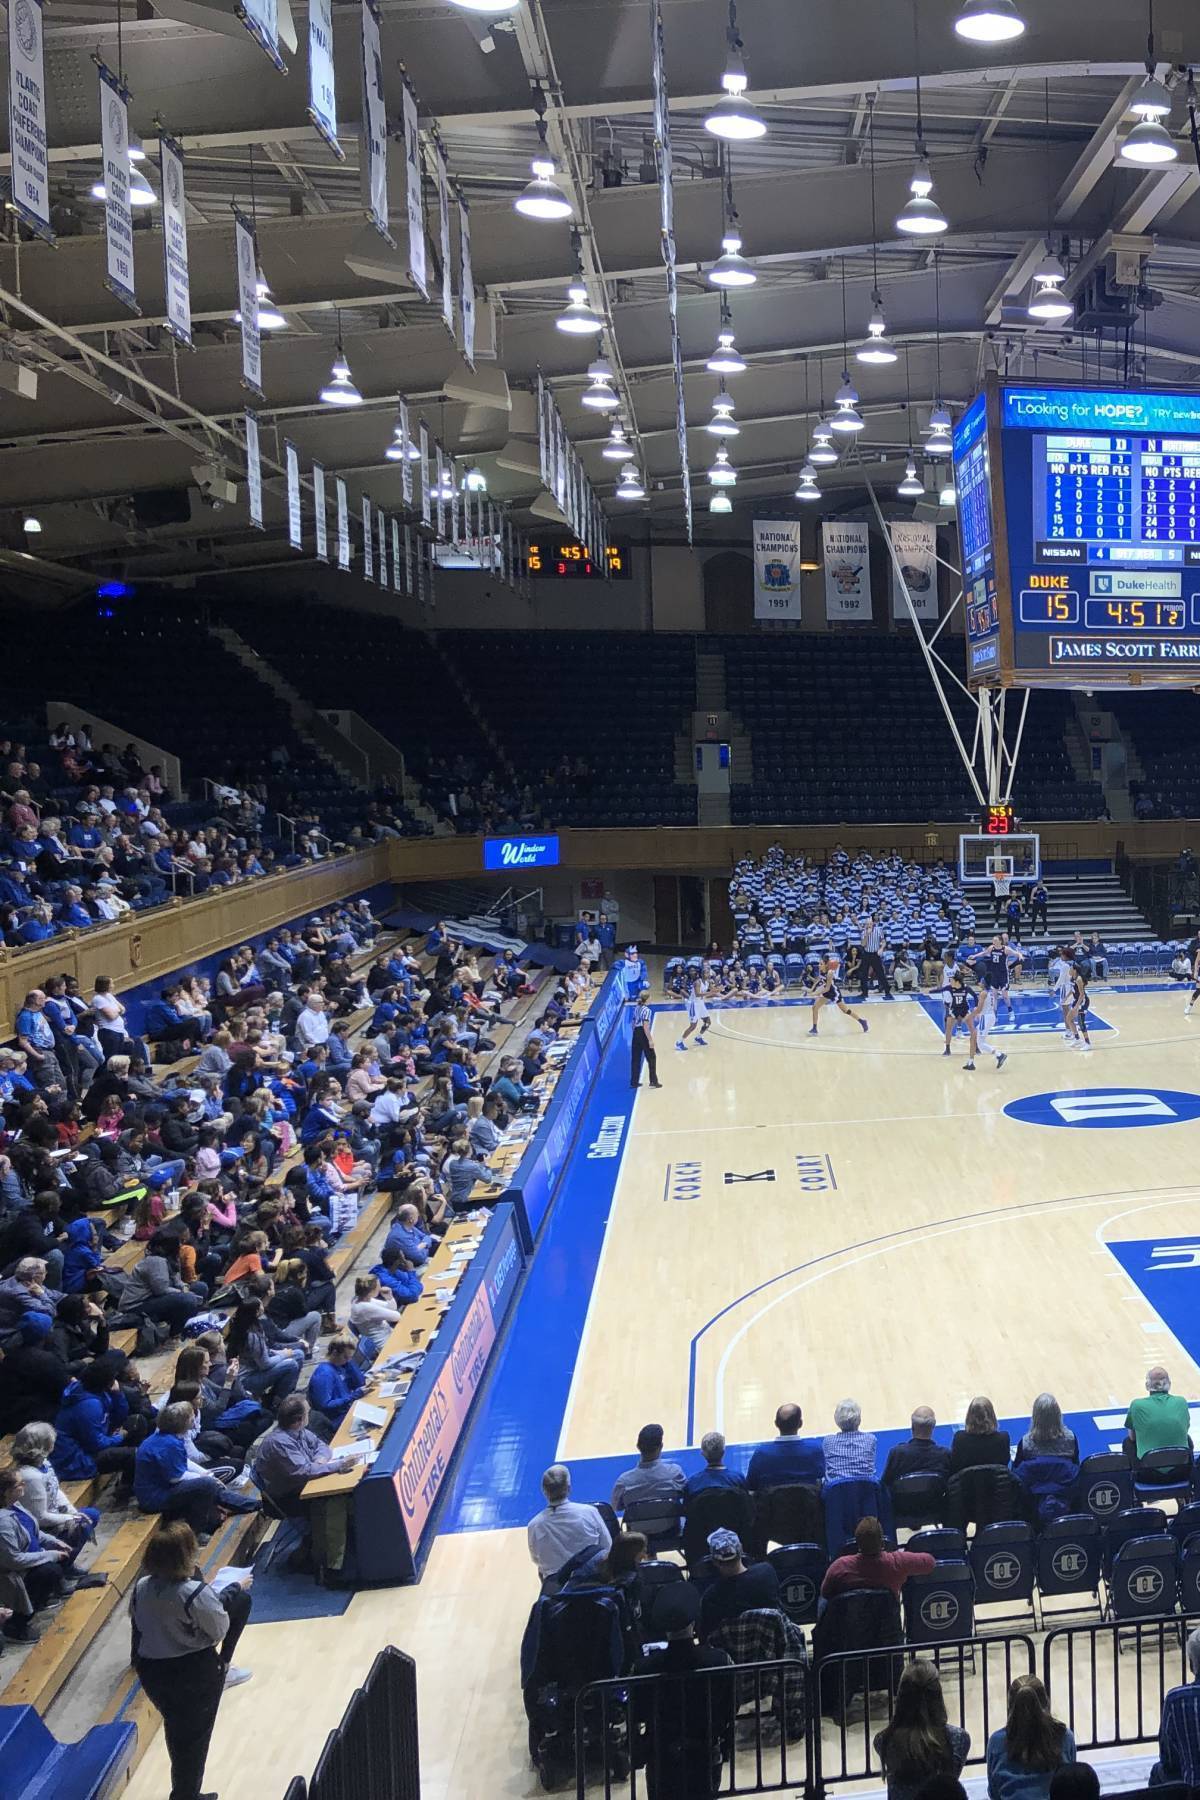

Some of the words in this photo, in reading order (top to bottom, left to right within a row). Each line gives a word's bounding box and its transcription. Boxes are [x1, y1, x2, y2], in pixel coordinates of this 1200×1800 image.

[1018, 401, 1068, 420] Looking
[1072, 404, 1091, 416] for
[1094, 404, 1144, 419] HOPE?
[1153, 409, 1171, 418] TRY
[1051, 464, 1065, 474] NO
[1070, 465, 1088, 475] PTS
[1091, 465, 1109, 475] REB
[1112, 466, 1129, 476] FLS
[1145, 467, 1158, 477] NO
[1164, 468, 1181, 477] PTS
[1055, 476, 1061, 486] 3
[1076, 477, 1082, 487] 3
[1097, 478, 1103, 488] 4
[1149, 479, 1155, 489] 3
[1170, 480, 1175, 490] 2
[1189, 481, 1195, 491] 4
[1055, 489, 1061, 499] 4
[1076, 489, 1082, 499] 0
[1097, 490, 1103, 500] 2
[1147, 492, 1156, 502] 12
[1169, 492, 1175, 502] 0
[1055, 501, 1061, 511] 5
[1076, 502, 1082, 512] 2
[1097, 502, 1103, 513] 2
[1118, 503, 1124, 513] 0
[1147, 504, 1156, 514] 21
[1169, 505, 1175, 515] 6
[1189, 505, 1195, 515] 4
[1053, 514, 1063, 524] 15
[1076, 515, 1082, 525] 0
[1097, 515, 1103, 525] 0
[1118, 516, 1124, 526] 0
[1146, 517, 1157, 527] 24
[1169, 517, 1175, 527] 3
[1189, 517, 1195, 527] 0
[760, 533, 794, 541] NATIONAL
[1052, 526, 1064, 536] 24
[1076, 527, 1082, 537] 0
[1097, 527, 1103, 537] 0
[1146, 529, 1157, 539] 44
[1169, 529, 1175, 539] 0
[830, 534, 862, 543] NATIONAL
[756, 543, 798, 552] CHAMPIONS
[826, 545, 867, 554] CHAMPIONS
[1043, 549, 1080, 557] NISSAN
[1097, 548, 1103, 558] 4
[528, 557, 540, 568] 15
[558, 564, 565, 573] 3
[610, 558, 621, 569] 19
[1030, 576, 1069, 588] DUKE
[1117, 580, 1177, 591] DukeHealth
[840, 600, 860, 608] 1992
[1047, 595, 1069, 620] 15
[1163, 604, 1183, 612] PERIOD
[1108, 603, 1161, 626] 4:51
[1169, 612, 1177, 625] 2
[1056, 641, 1101, 658] JAMES
[1106, 642, 1155, 657] SCOTT
[990, 807, 1012, 817] 4:51
[988, 817, 1008, 833] 23
[955, 996, 963, 1004] 12
[673, 1161, 702, 1201] COACH
[796, 1153, 829, 1191] COURT
[451, 1300, 484, 1395] Continental
[469, 1352, 485, 1391] TIRE
[399, 1392, 444, 1518] Continental
[422, 1451, 445, 1509] TIRE
